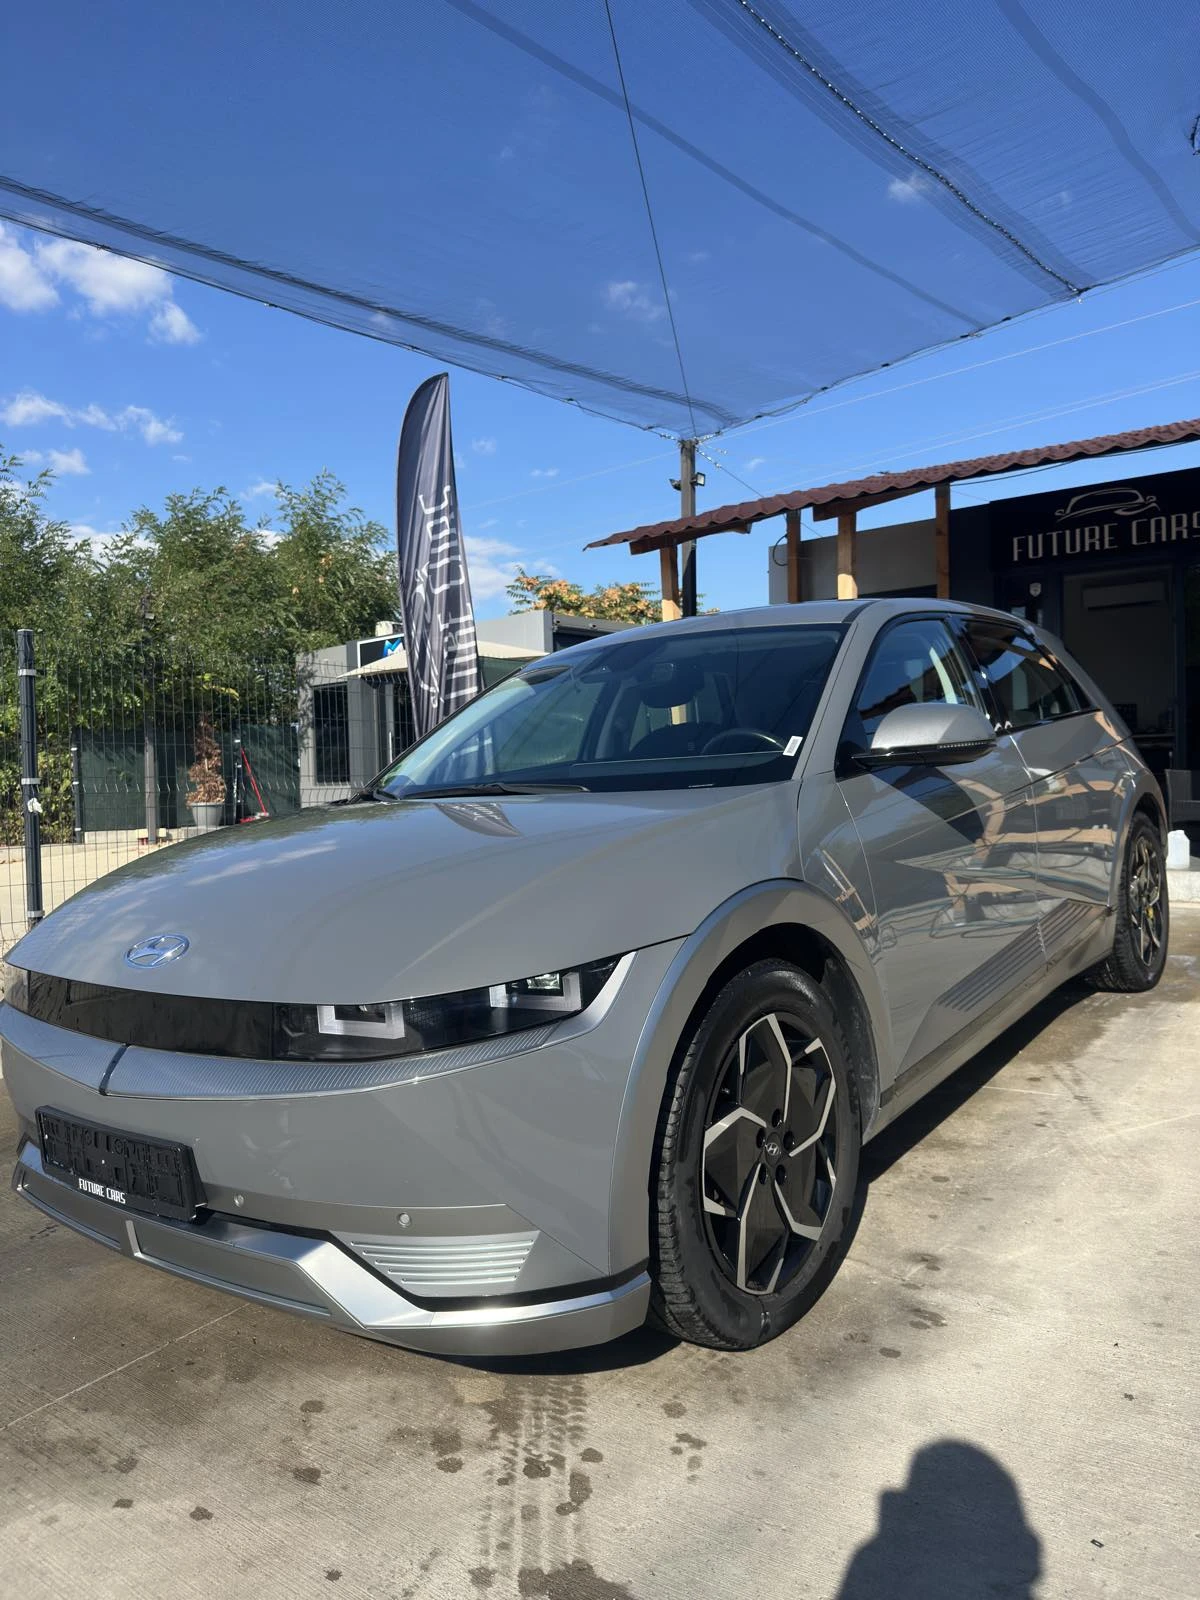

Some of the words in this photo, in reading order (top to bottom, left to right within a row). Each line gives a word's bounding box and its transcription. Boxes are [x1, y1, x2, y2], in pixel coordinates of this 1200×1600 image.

[1012, 522, 1118, 562] FUTURE
[78, 1178, 105, 1198] FUTURE
[106, 1187, 126, 1205] CARS
